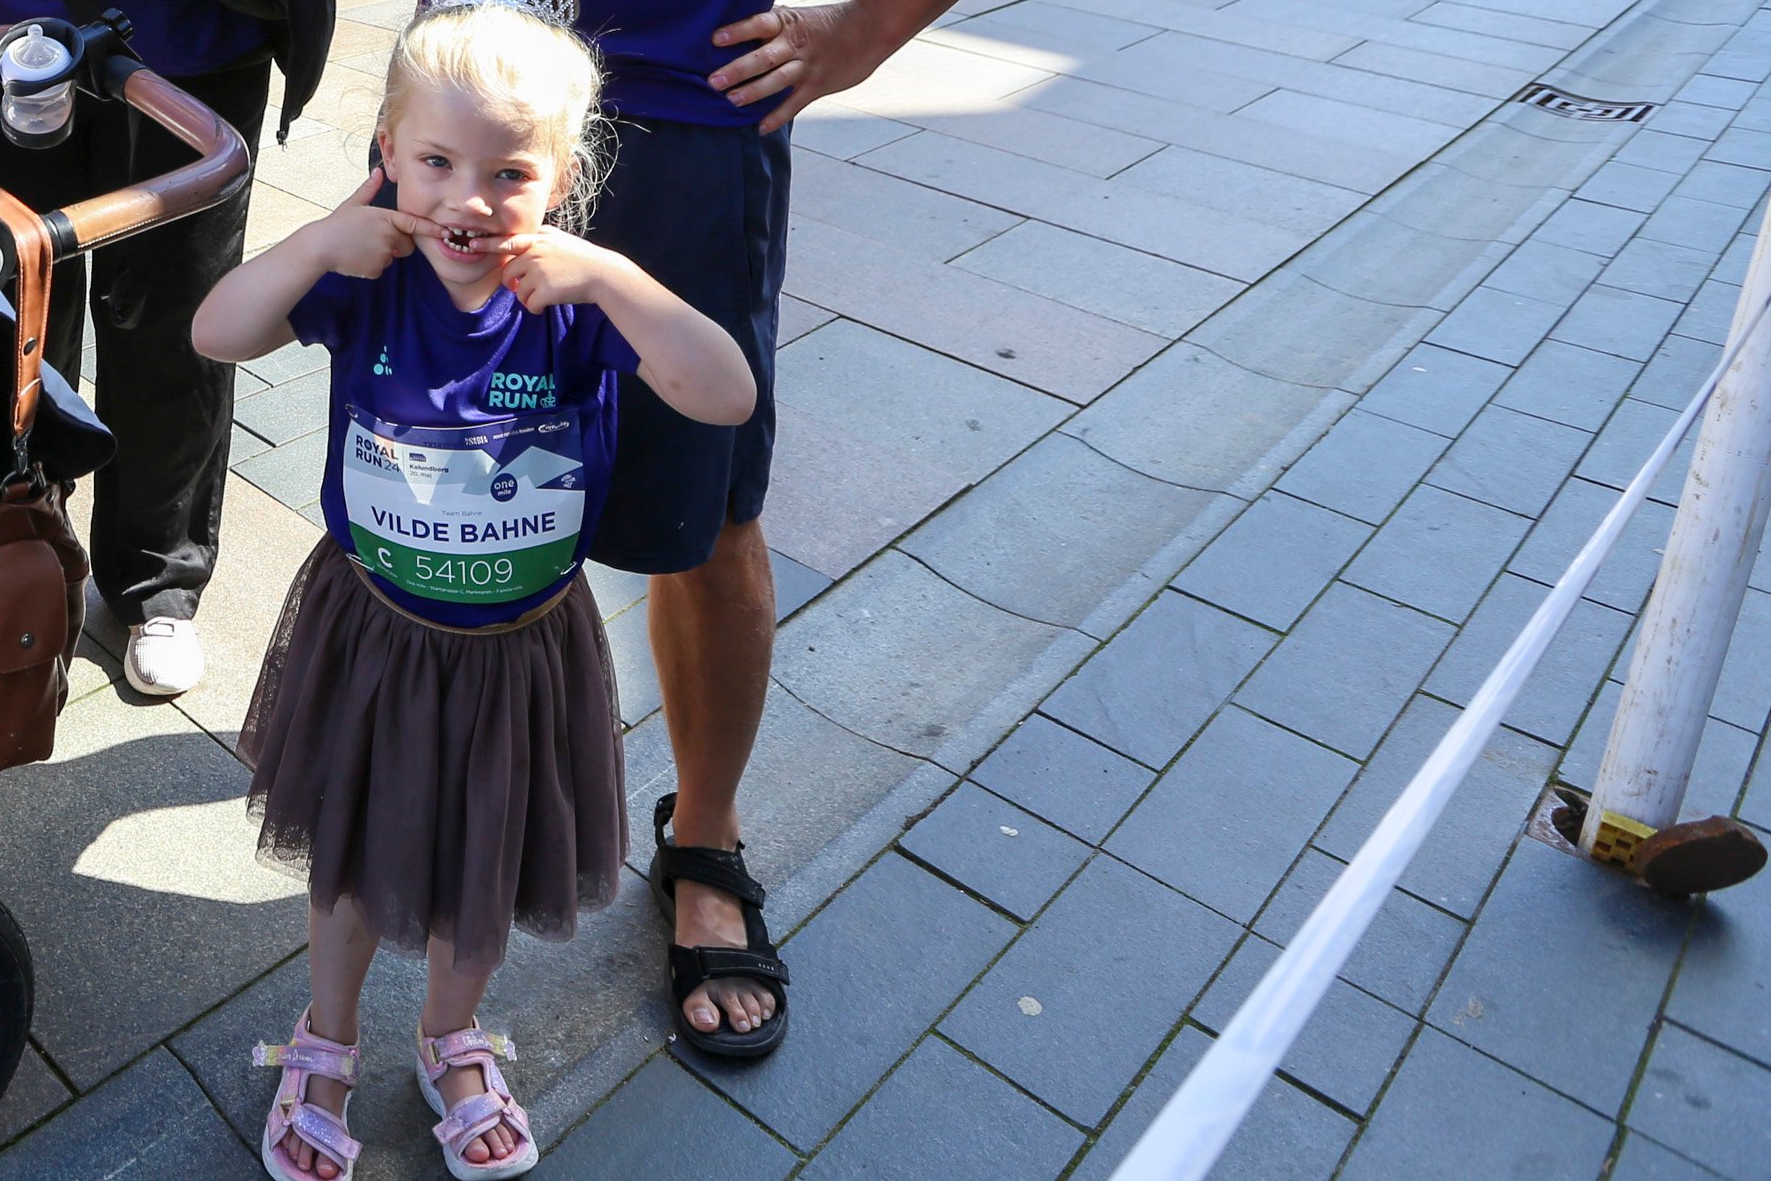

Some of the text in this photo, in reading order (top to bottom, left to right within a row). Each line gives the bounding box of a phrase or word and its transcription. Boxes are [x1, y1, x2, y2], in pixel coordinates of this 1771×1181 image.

[491, 373, 556, 392] ROYAL
[489, 391, 537, 409] RUN
[356, 435, 399, 460] ROYAL
[356, 448, 383, 468] RUN
[409, 464, 449, 473] Kalundborg
[494, 480, 515, 489] one
[371, 505, 556, 544] VILDE BAHNE
[378, 547, 393, 568] C
[415, 555, 514, 586] 54109
